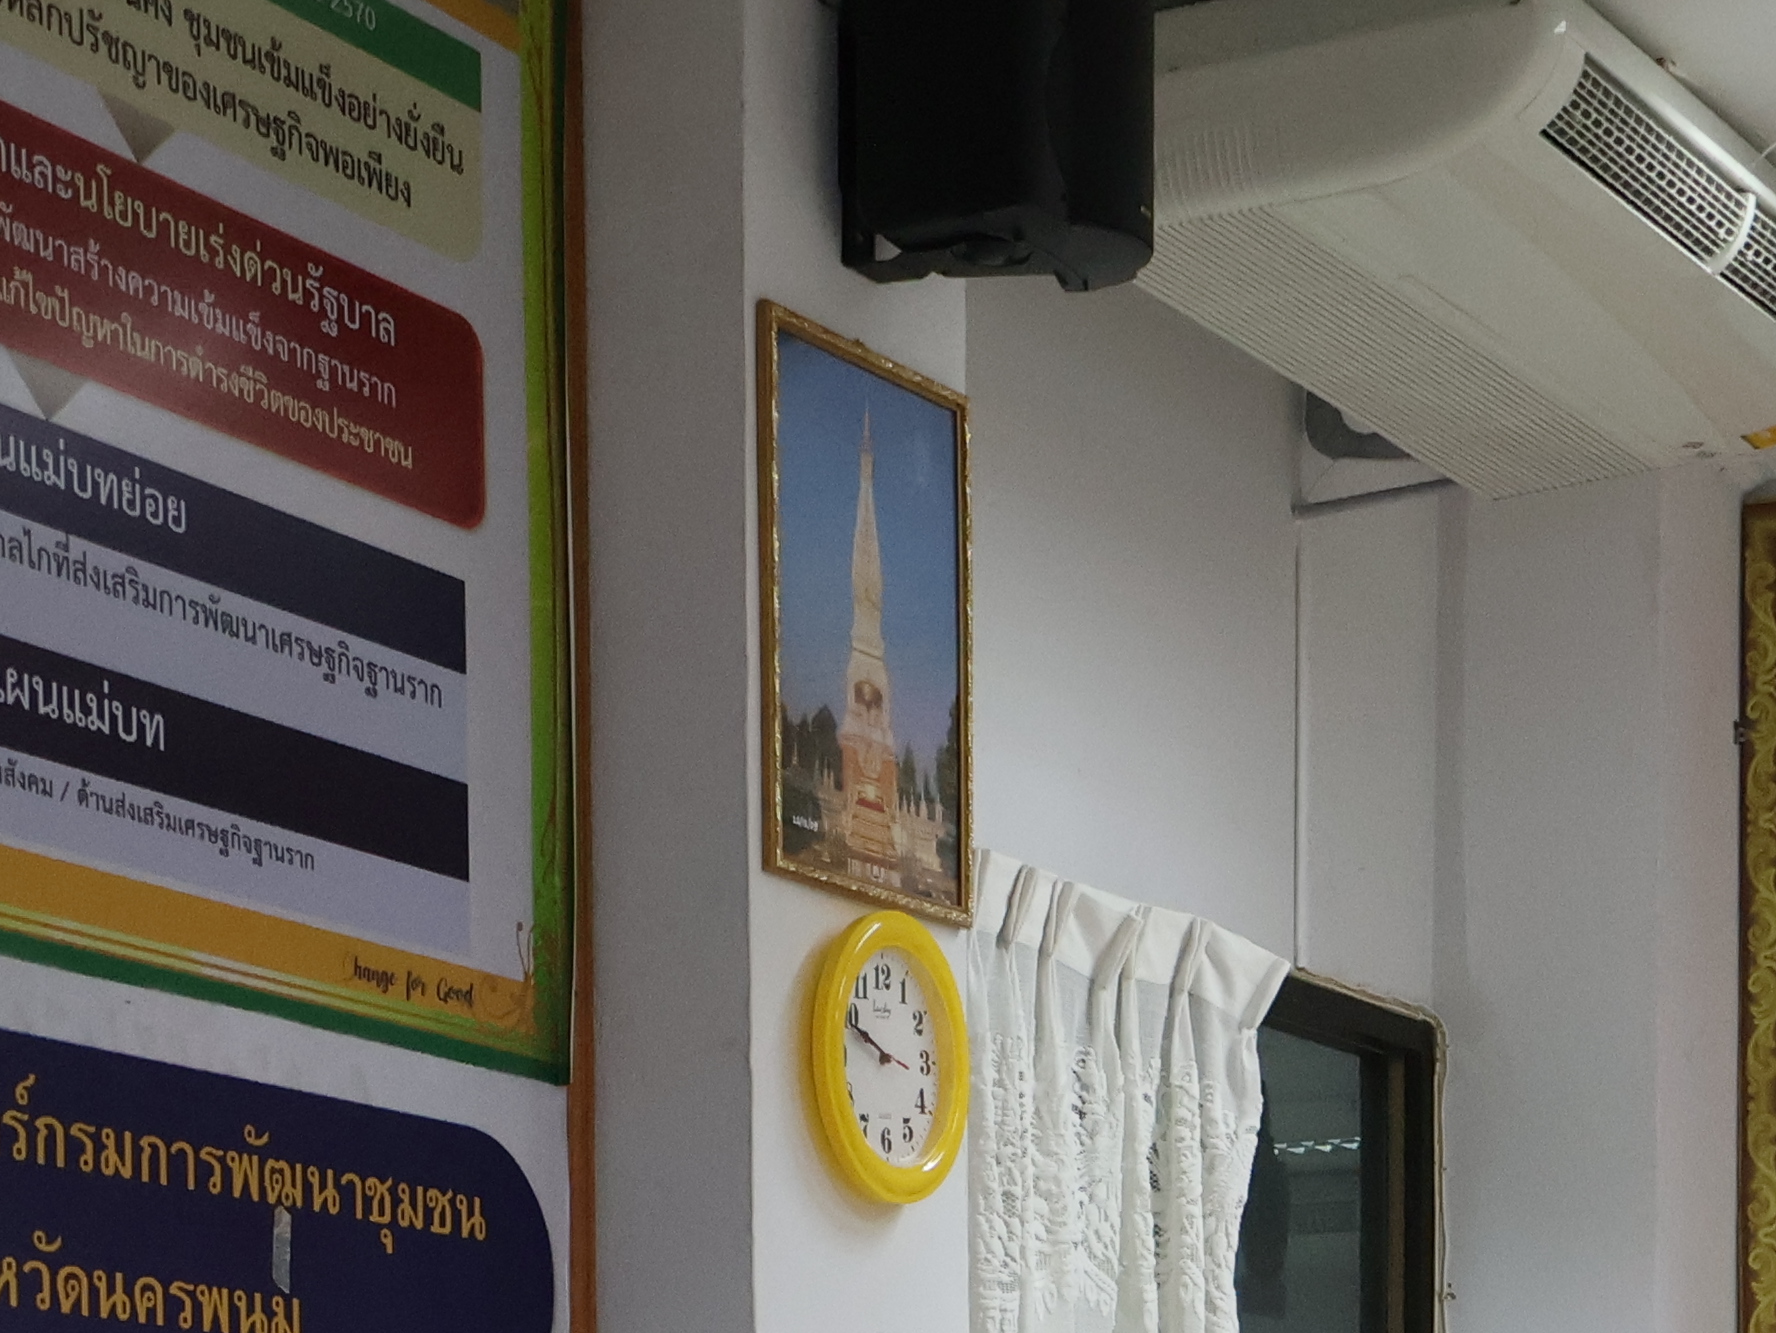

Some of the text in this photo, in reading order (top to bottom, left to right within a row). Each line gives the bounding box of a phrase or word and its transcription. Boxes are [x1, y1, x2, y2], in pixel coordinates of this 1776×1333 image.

[60, 779, 70, 802] /
[873, 963, 892, 991] 12
[898, 977, 908, 1004] 1
[434, 978, 475, 1008] Good
[913, 1010, 925, 1037] 2
[919, 1049, 931, 1076] 3
[914, 1087, 926, 1115] 4
[880, 1127, 892, 1154] 6
[902, 1117, 914, 1143] 5
